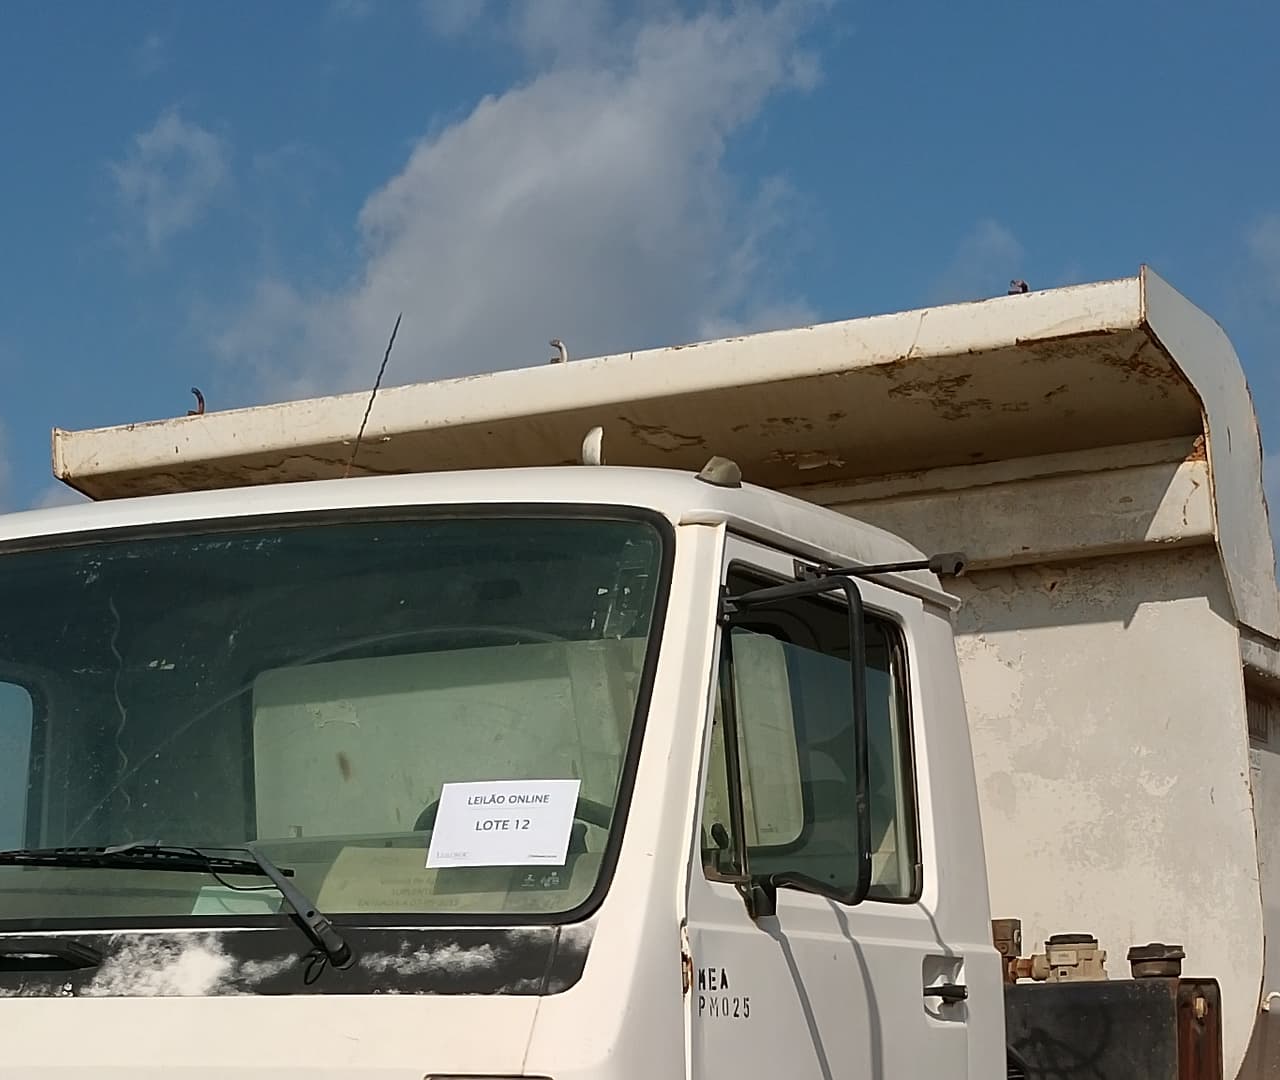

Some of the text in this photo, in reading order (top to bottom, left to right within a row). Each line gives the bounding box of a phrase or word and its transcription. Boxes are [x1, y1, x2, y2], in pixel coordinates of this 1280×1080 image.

[467, 793, 550, 806] LEILÃO ONLINE
[475, 819, 531, 831] LOTE 12
